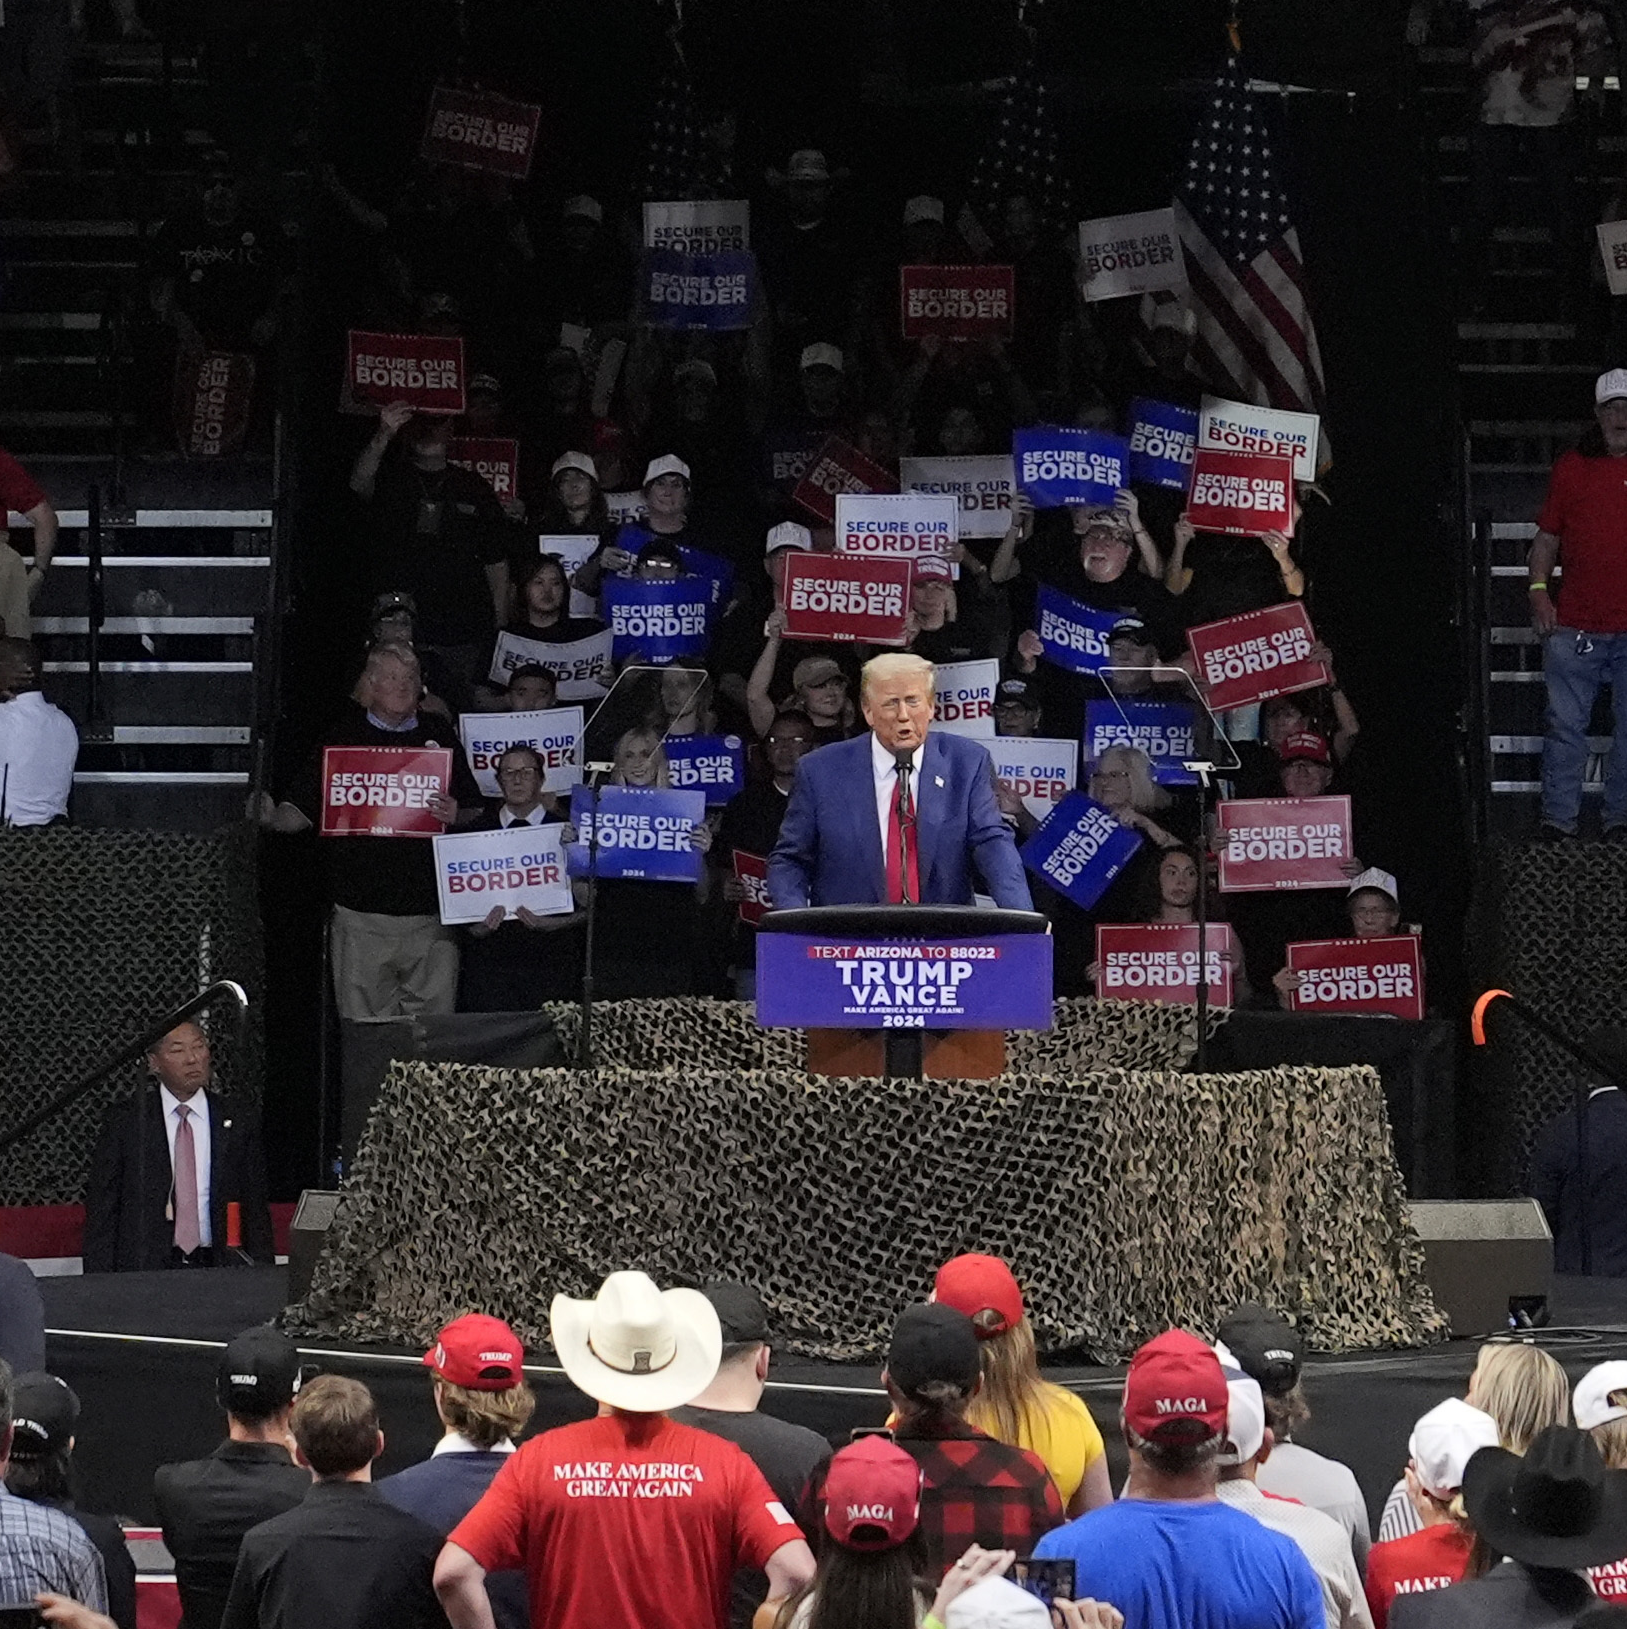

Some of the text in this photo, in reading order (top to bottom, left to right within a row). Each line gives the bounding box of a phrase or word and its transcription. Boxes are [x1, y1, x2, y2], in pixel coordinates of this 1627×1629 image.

[650, 284, 747, 307] BORDER
[908, 288, 1006, 303] SECURE OUR
[908, 300, 1007, 318] BORDER
[356, 354, 455, 371] SECURE OUR
[355, 367, 458, 390] BORDER
[1209, 416, 1307, 443] SECURE OUR
[1023, 450, 1121, 471] SECURE OUR
[1022, 461, 1122, 487] BORDER
[1197, 473, 1285, 493] SECURE OUR
[1193, 486, 1286, 512] BORDER
[846, 520, 948, 533] SECURE OUR
[792, 578, 902, 597] SECURE OUR
[612, 604, 705, 618] SECURE OUR
[791, 591, 902, 616] BORDER
[612, 616, 705, 636] BORDER
[1204, 625, 1305, 667] SECURE OUR
[1207, 641, 1312, 683] BORDER
[953, 687, 990, 703] OUR
[698, 755, 732, 768] OUR
[331, 773, 441, 789] SECURE OUR
[1030, 764, 1066, 779] OUR
[580, 812, 692, 832] SECURE OUR
[1228, 824, 1341, 842] SECURE OUR
[1227, 837, 1342, 861] BORDER
[447, 852, 557, 874] SECURE OUR
[448, 865, 560, 894] BORDER
[813, 946, 995, 958] TEXT ARIZONA TO 88022
[836, 961, 972, 985] TRUMP
[1298, 963, 1411, 986] SECURE OUR
[852, 985, 957, 1006] VANCE
[1298, 978, 1414, 1003] BORDER
[882, 1015, 924, 1027] 2024
[478, 1351, 513, 1363] TRUMP
[1263, 1348, 1295, 1361] TRUMP
[1155, 1397, 1208, 1415] MAGA
[554, 1463, 703, 1481] MAKE AMERICA
[567, 1480, 692, 1498] GREAT AGAIN
[846, 1503, 894, 1521] MAGA
[1394, 1576, 1451, 1594] MAKE
